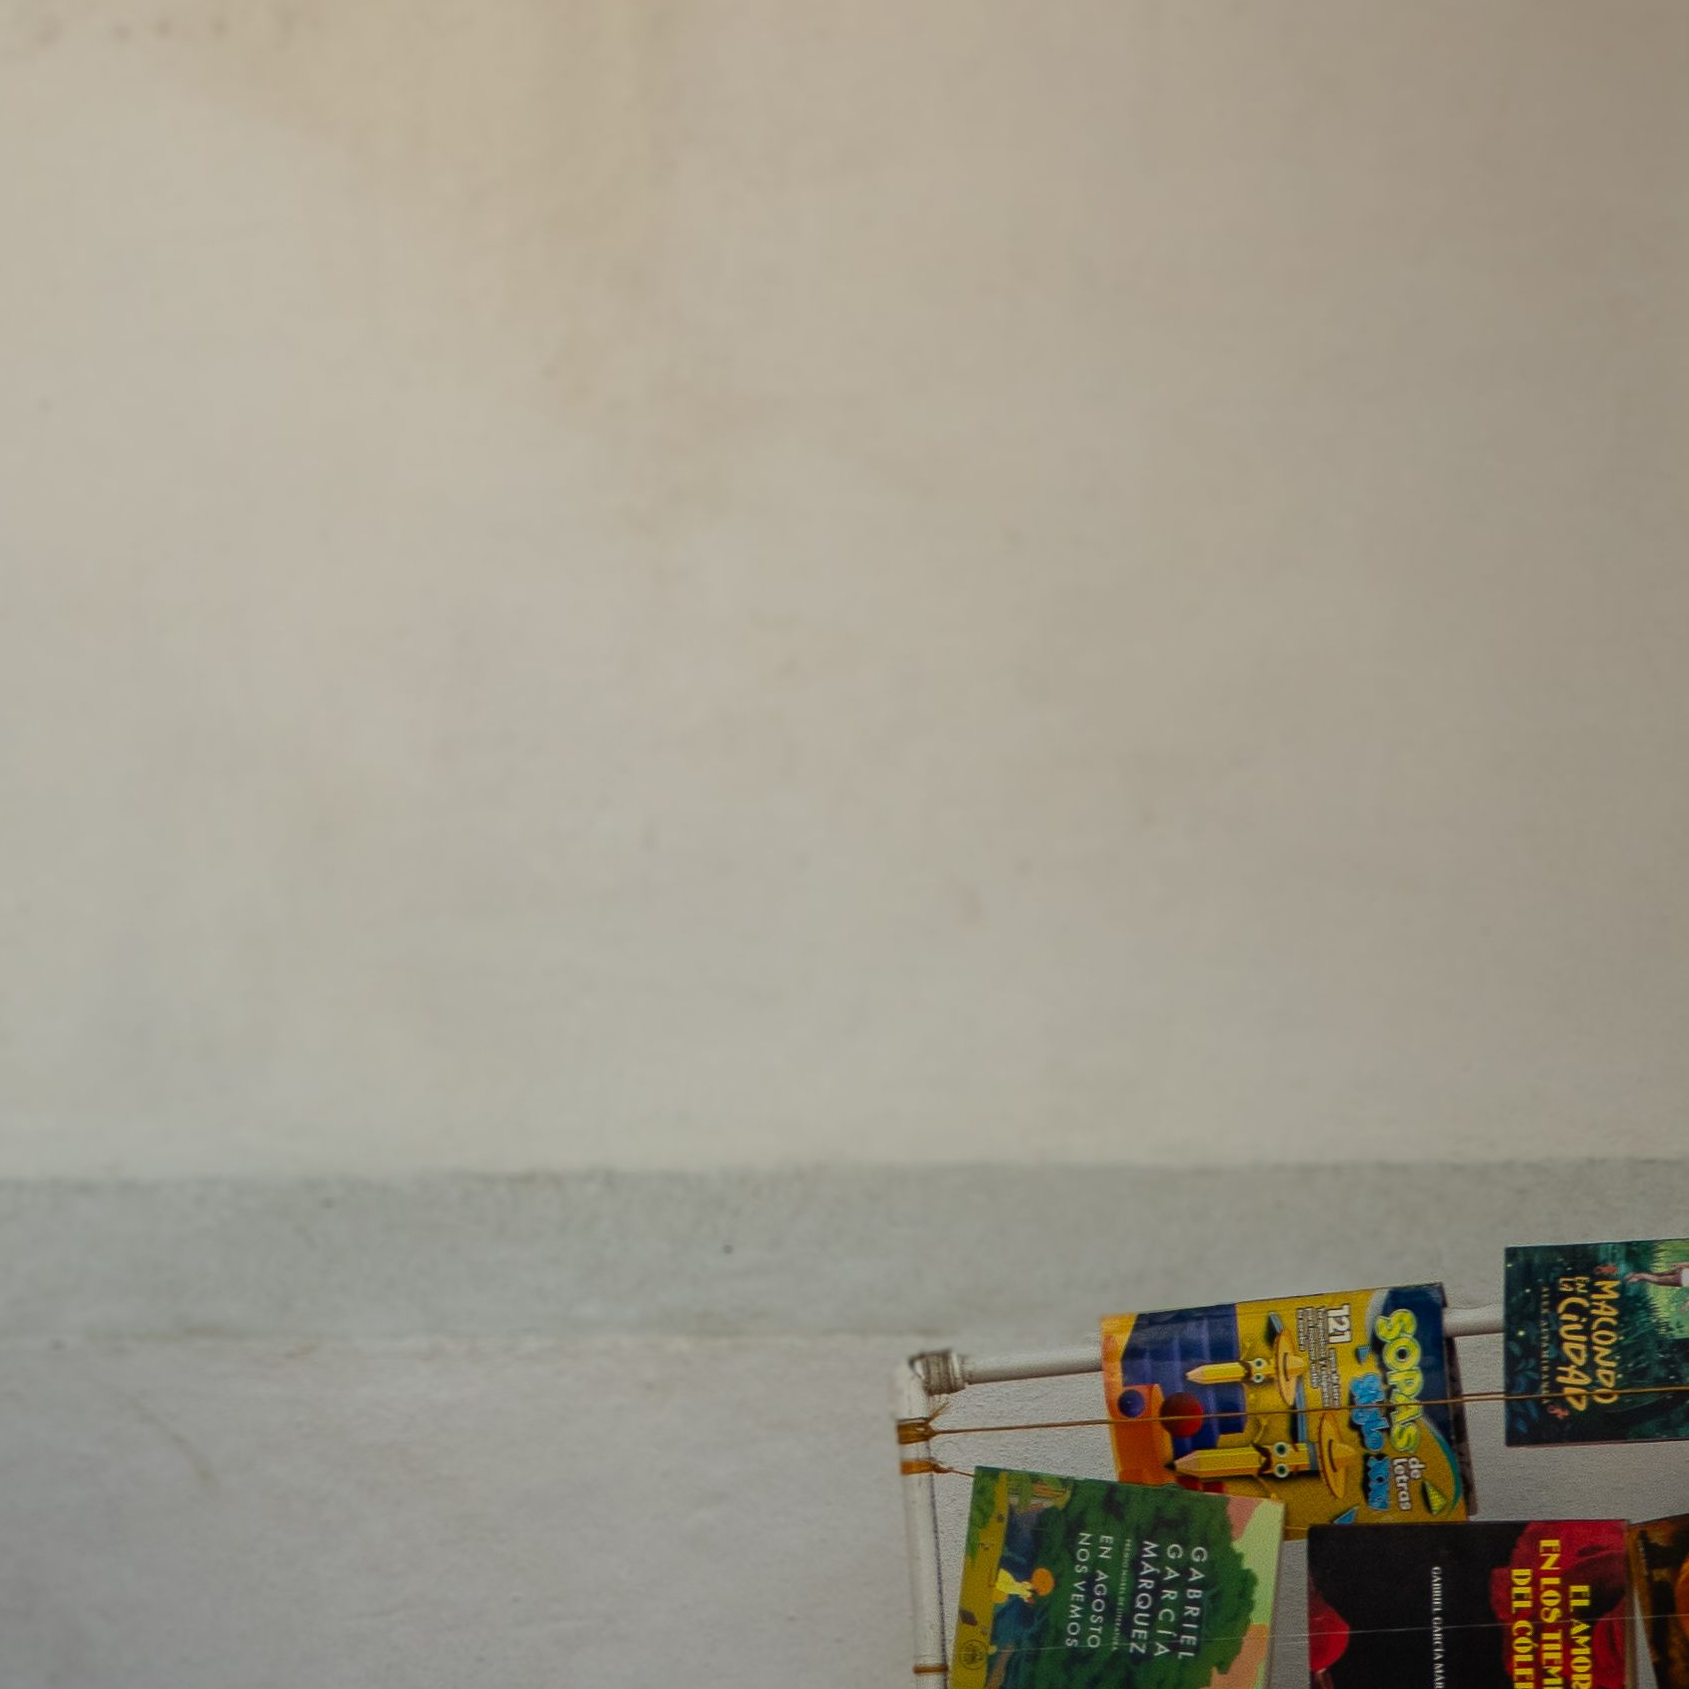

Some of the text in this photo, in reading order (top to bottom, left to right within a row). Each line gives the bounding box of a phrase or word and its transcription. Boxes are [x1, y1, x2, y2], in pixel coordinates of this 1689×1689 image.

[1576, 1276, 1590, 1293] EN
[1327, 1304, 1351, 1344] 121
[1374, 1309, 1425, 1454] SOPAS
[1392, 1458, 1412, 1511] letras
[1408, 1457, 1426, 1479] de
[1539, 1539, 1561, 1571] EN
[1065, 1532, 1091, 1648] NOS VEMOS
[1087, 1535, 1113, 1649] EN AGOSTO
[1129, 1541, 1160, 1655] MÁRQUEZ
[1153, 1543, 1182, 1657] GARCÍA
[1177, 1546, 1208, 1660] GABRIEL
[1431, 1567, 1443, 1614] GABRIEL
[1510, 1568, 1535, 1614] DEL
[1540, 1577, 1563, 1623] LOS
[1569, 1585, 1591, 1612] EL
[1431, 1616, 1446, 1661] GARCÍA
